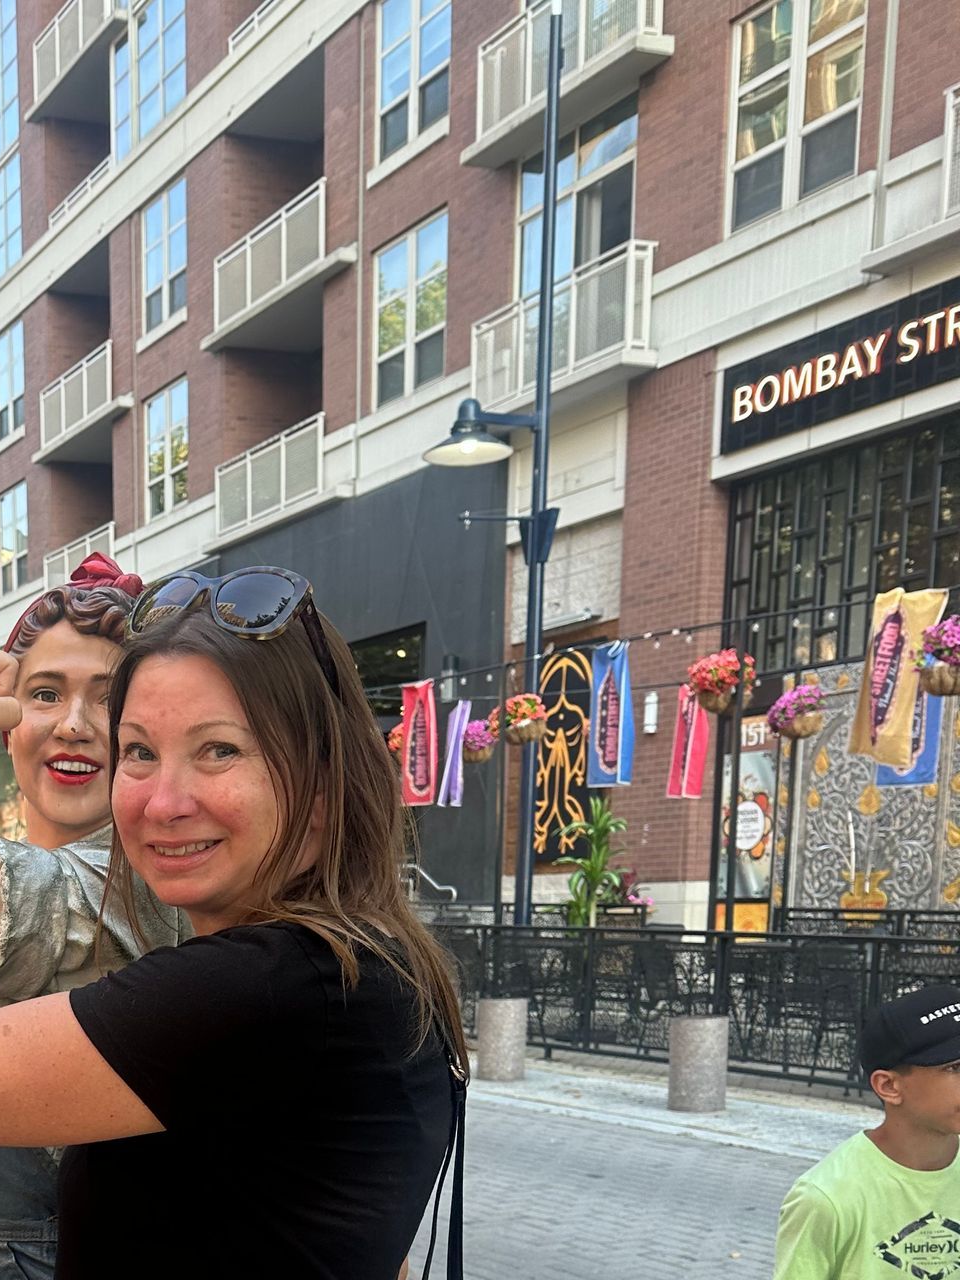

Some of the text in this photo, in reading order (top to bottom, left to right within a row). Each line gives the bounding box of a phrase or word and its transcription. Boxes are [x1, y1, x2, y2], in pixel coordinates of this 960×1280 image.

[731, 332, 890, 423] BOMBAY
[880, 621, 901, 657] FOOD
[904, 1241, 946, 1254] Hurley
